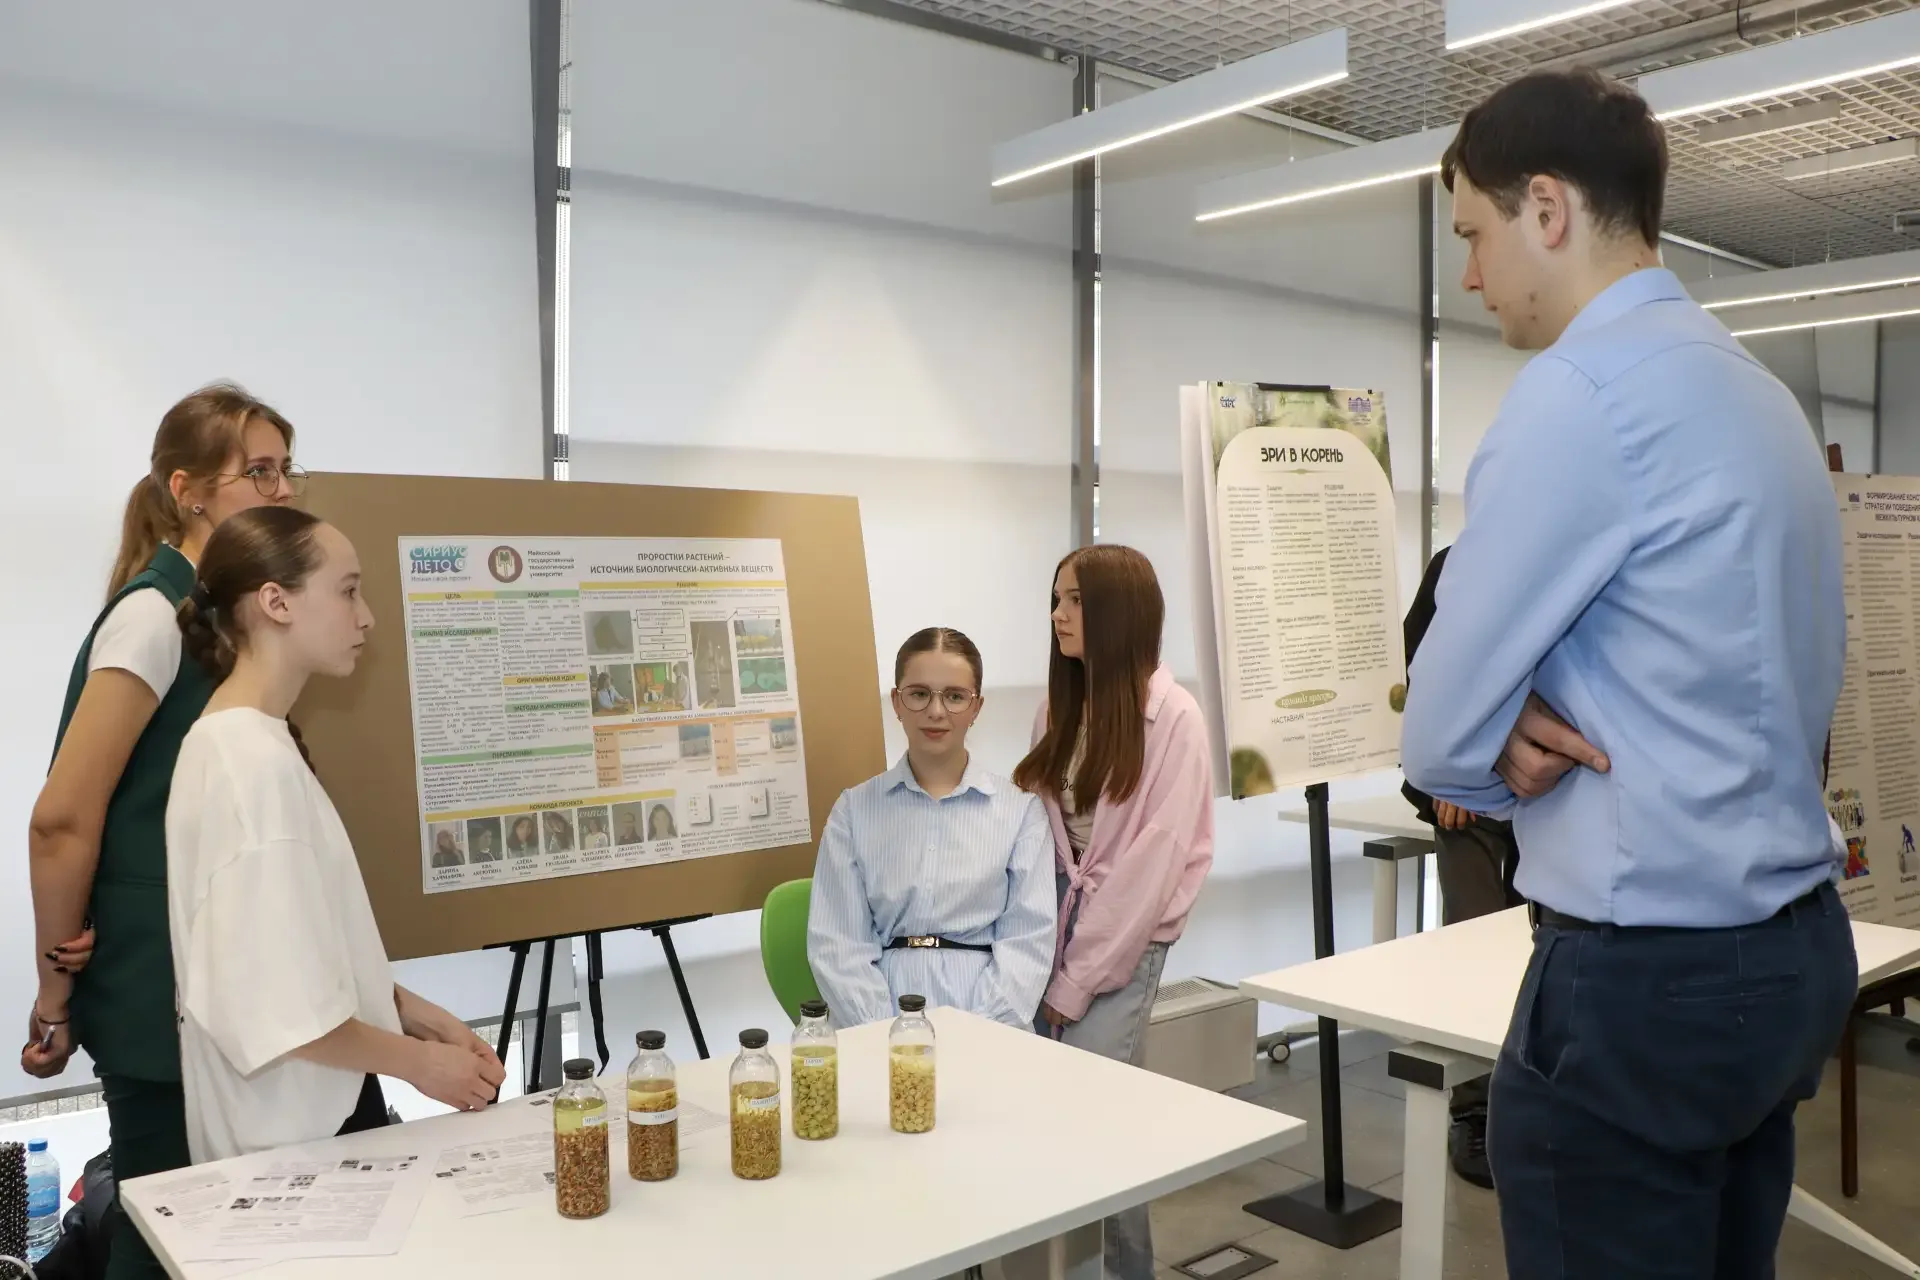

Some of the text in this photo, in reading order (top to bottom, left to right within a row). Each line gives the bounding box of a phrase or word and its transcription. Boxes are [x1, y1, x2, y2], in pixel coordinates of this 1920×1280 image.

[1260, 447, 1344, 463] ЗРИ В КОРЕНЬ
[411, 544, 468, 559] СИРИУС
[527, 557, 575, 565] государственный
[637, 553, 684, 561] ПРОРОСТКИ
[685, 552, 724, 561] РАСТЕНИЙ
[412, 559, 452, 573] ЛЕТО
[590, 565, 774, 574] ИСТОЧНИК БИОЛОГИЧЕСКИ-АКТИВНЫХ ВЕЩЕСТВ
[529, 571, 564, 579] университет
[419, 628, 492, 637] АНАЛИЗ ИССЛЕДОВАНИЙ
[516, 676, 561, 684] ОРИГИНАЛЬНАЯ
[1271, 713, 1305, 724] НАСТАВНИК
[529, 801, 559, 810] КОМАНДА
